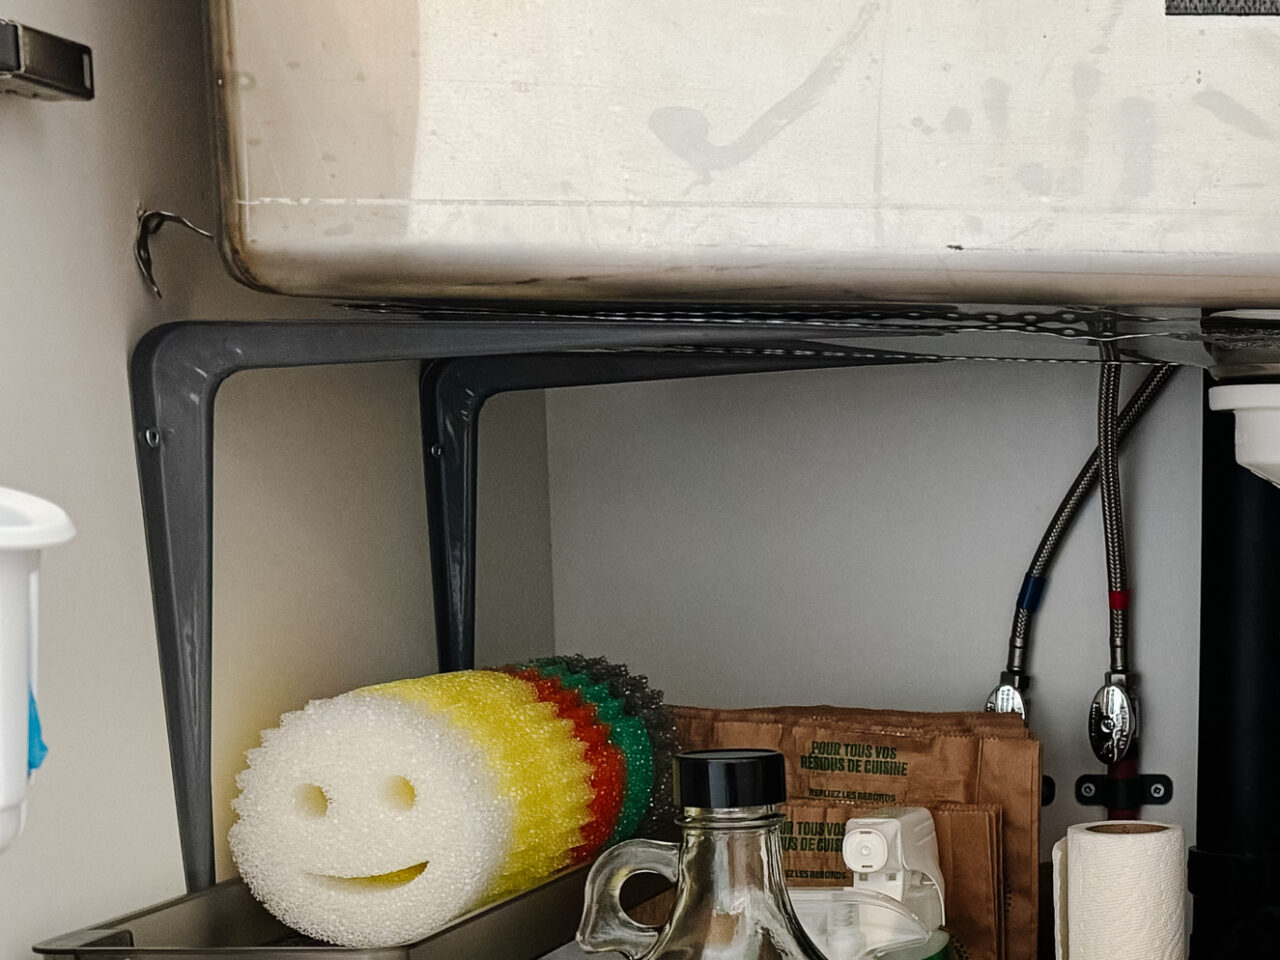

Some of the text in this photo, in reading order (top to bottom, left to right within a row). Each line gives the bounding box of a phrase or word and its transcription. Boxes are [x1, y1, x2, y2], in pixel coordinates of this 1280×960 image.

[812, 741, 897, 759] POUR TOUS VOS
[847, 760, 862, 773] DE
[864, 760, 908, 776] CUISINE
[842, 791, 856, 799] LES
[797, 822, 825, 836] TOUS
[801, 838, 814, 851] DE
